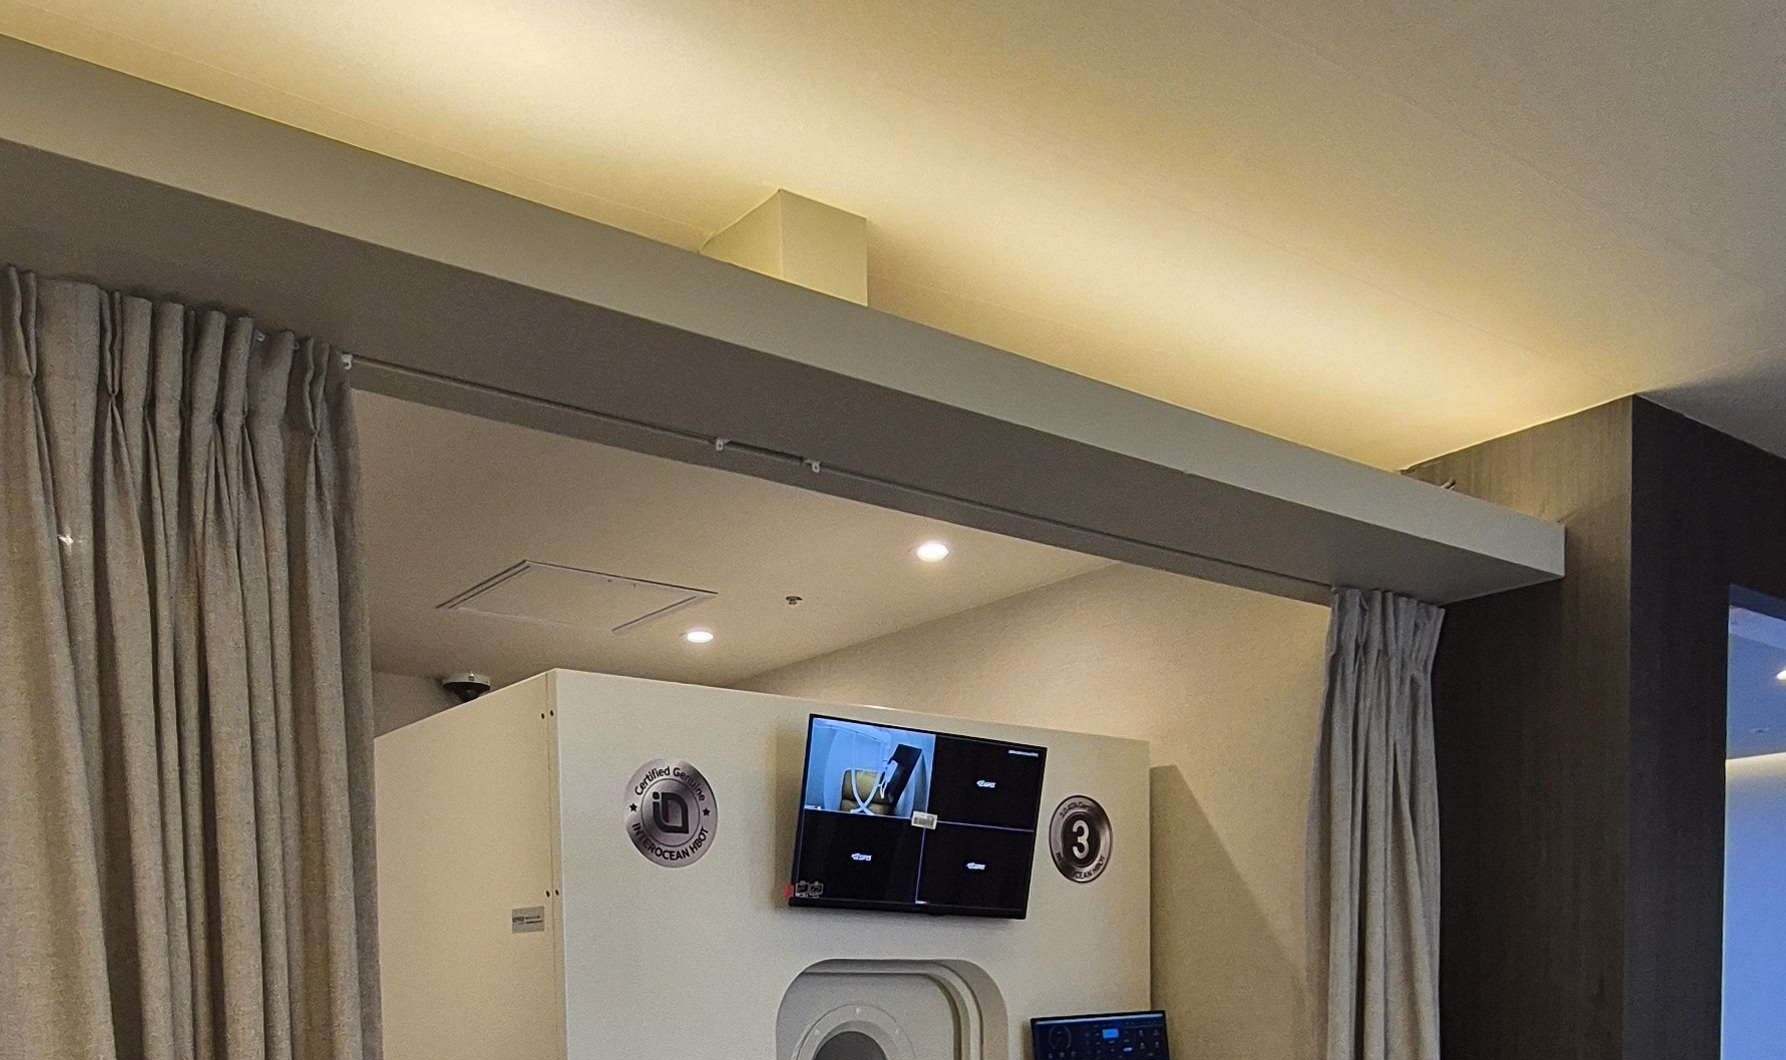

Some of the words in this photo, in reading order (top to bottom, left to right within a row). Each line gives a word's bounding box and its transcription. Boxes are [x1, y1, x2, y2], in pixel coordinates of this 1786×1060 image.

[635, 766, 670, 796] Certified
[673, 767, 706, 802] Genuine
[632, 822, 690, 861] INTEROCEAN
[690, 825, 709, 853] HBOT
[1072, 819, 1090, 860] 3
